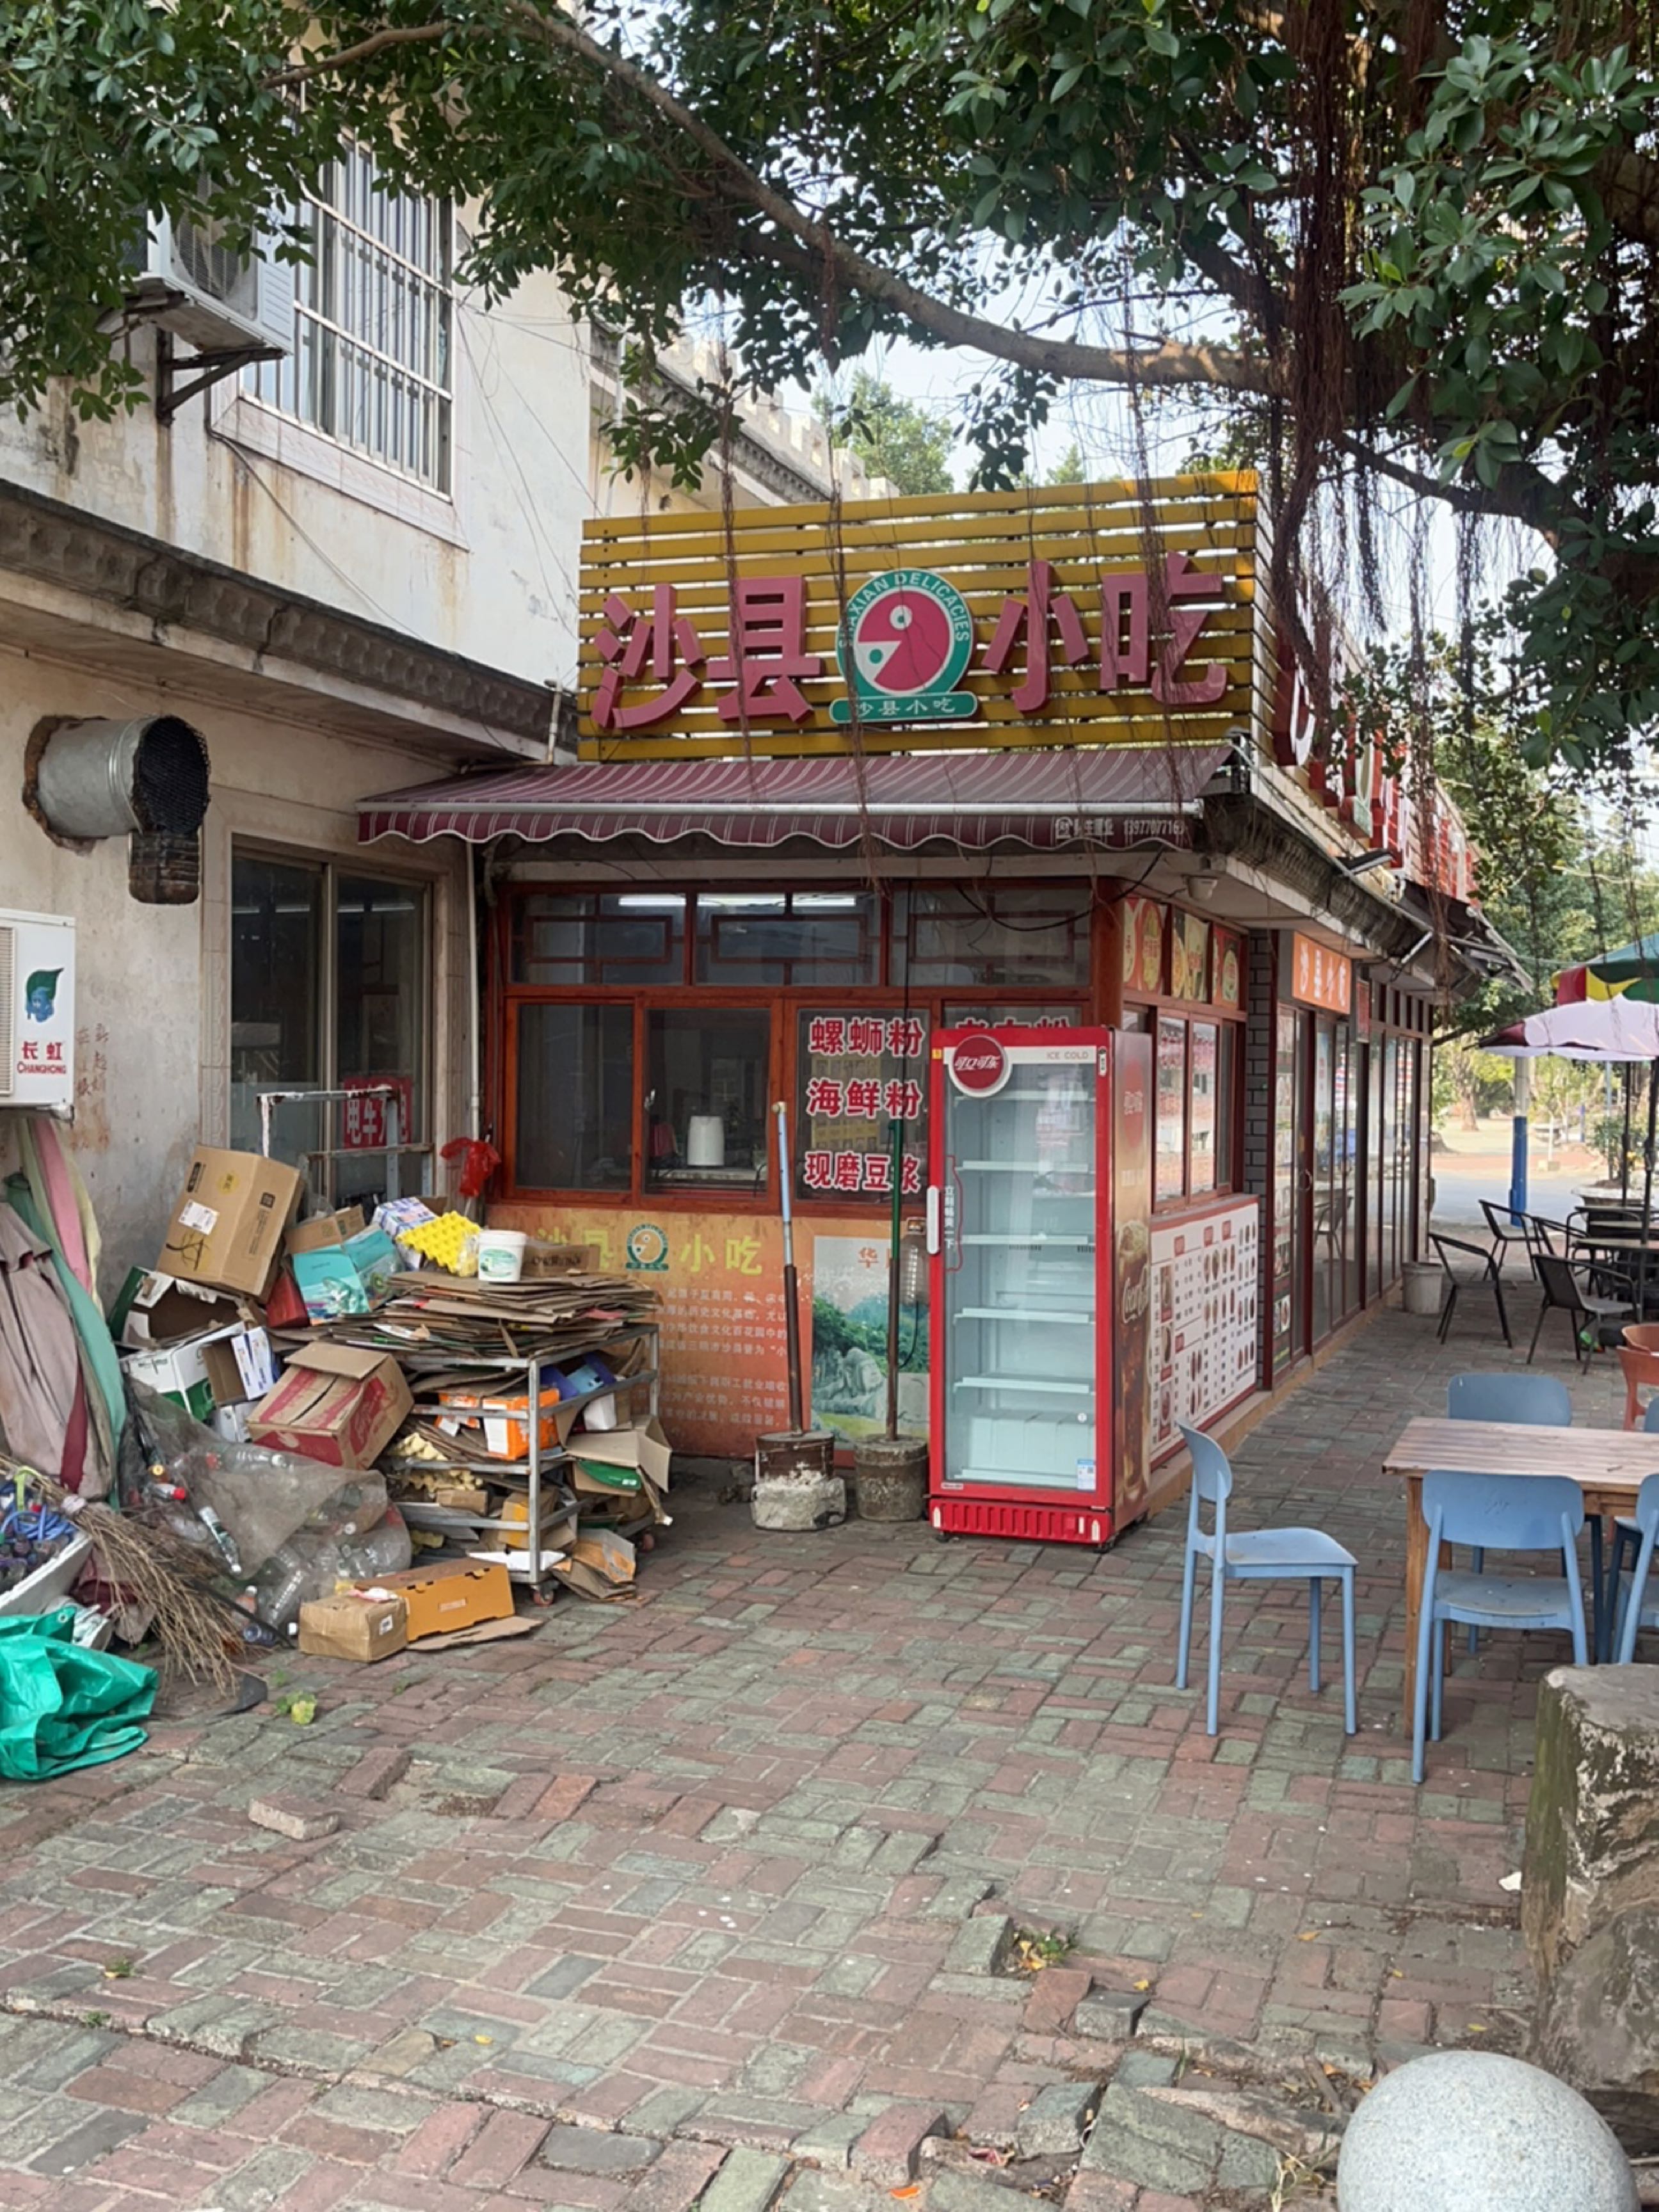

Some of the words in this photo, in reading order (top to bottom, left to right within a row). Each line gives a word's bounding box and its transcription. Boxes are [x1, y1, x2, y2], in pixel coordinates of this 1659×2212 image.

[894, 572, 970, 642] DELICACIES
[593, 575, 821, 728] 沙县
[981, 551, 1228, 712] 小吃
[22, 1041, 63, 1061] 长虹
[808, 1017, 926, 1057] 螺蛳粉
[1046, 1052, 1061, 1060] ICE
[1064, 1052, 1089, 1060] COLD
[346, 1084, 410, 1146] 电车电
[806, 1078, 922, 1119] 海鲜粉
[803, 1151, 921, 1194] 现磨豆浆
[679, 1233, 764, 1276] 小吃
